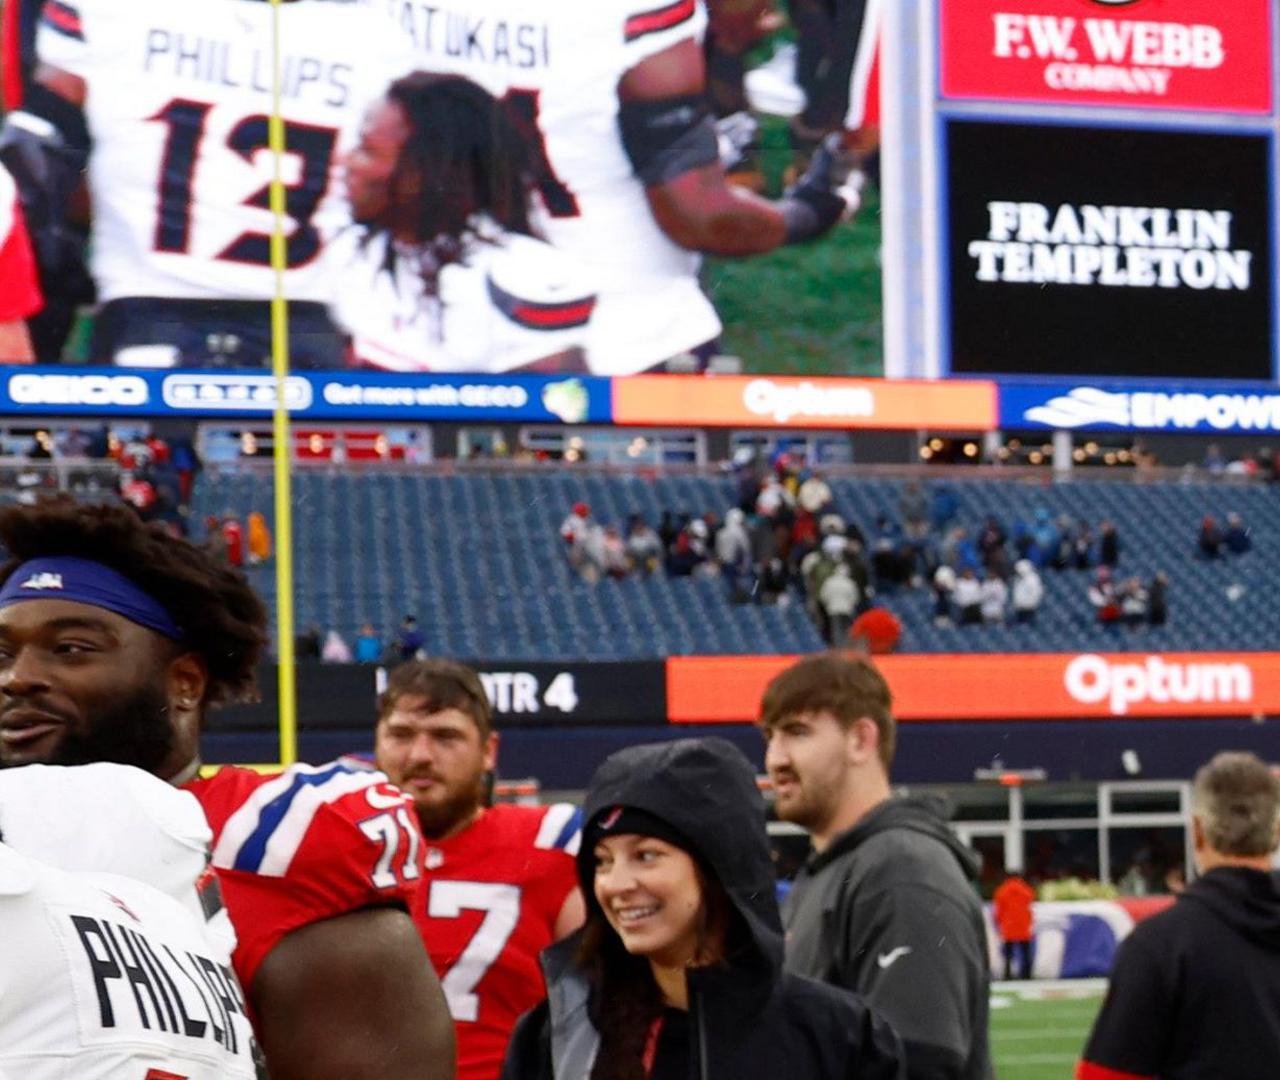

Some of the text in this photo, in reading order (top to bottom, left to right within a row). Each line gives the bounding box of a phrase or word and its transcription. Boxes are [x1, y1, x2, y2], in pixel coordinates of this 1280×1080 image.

[144, 28, 353, 107] PHILLIPS
[993, 13, 1224, 68] F.W. WEBB
[1044, 61, 1171, 95] COMPANY
[142, 98, 339, 270] 13
[987, 200, 1231, 250] FRANKLIN
[968, 240, 1252, 290] TEMPLETON
[743, 379, 873, 421] Optum
[479, 672, 578, 713] TR 4
[1064, 653, 1253, 715] Optum
[357, 805, 421, 891] 71
[69, 914, 263, 1062] PHILLIP
